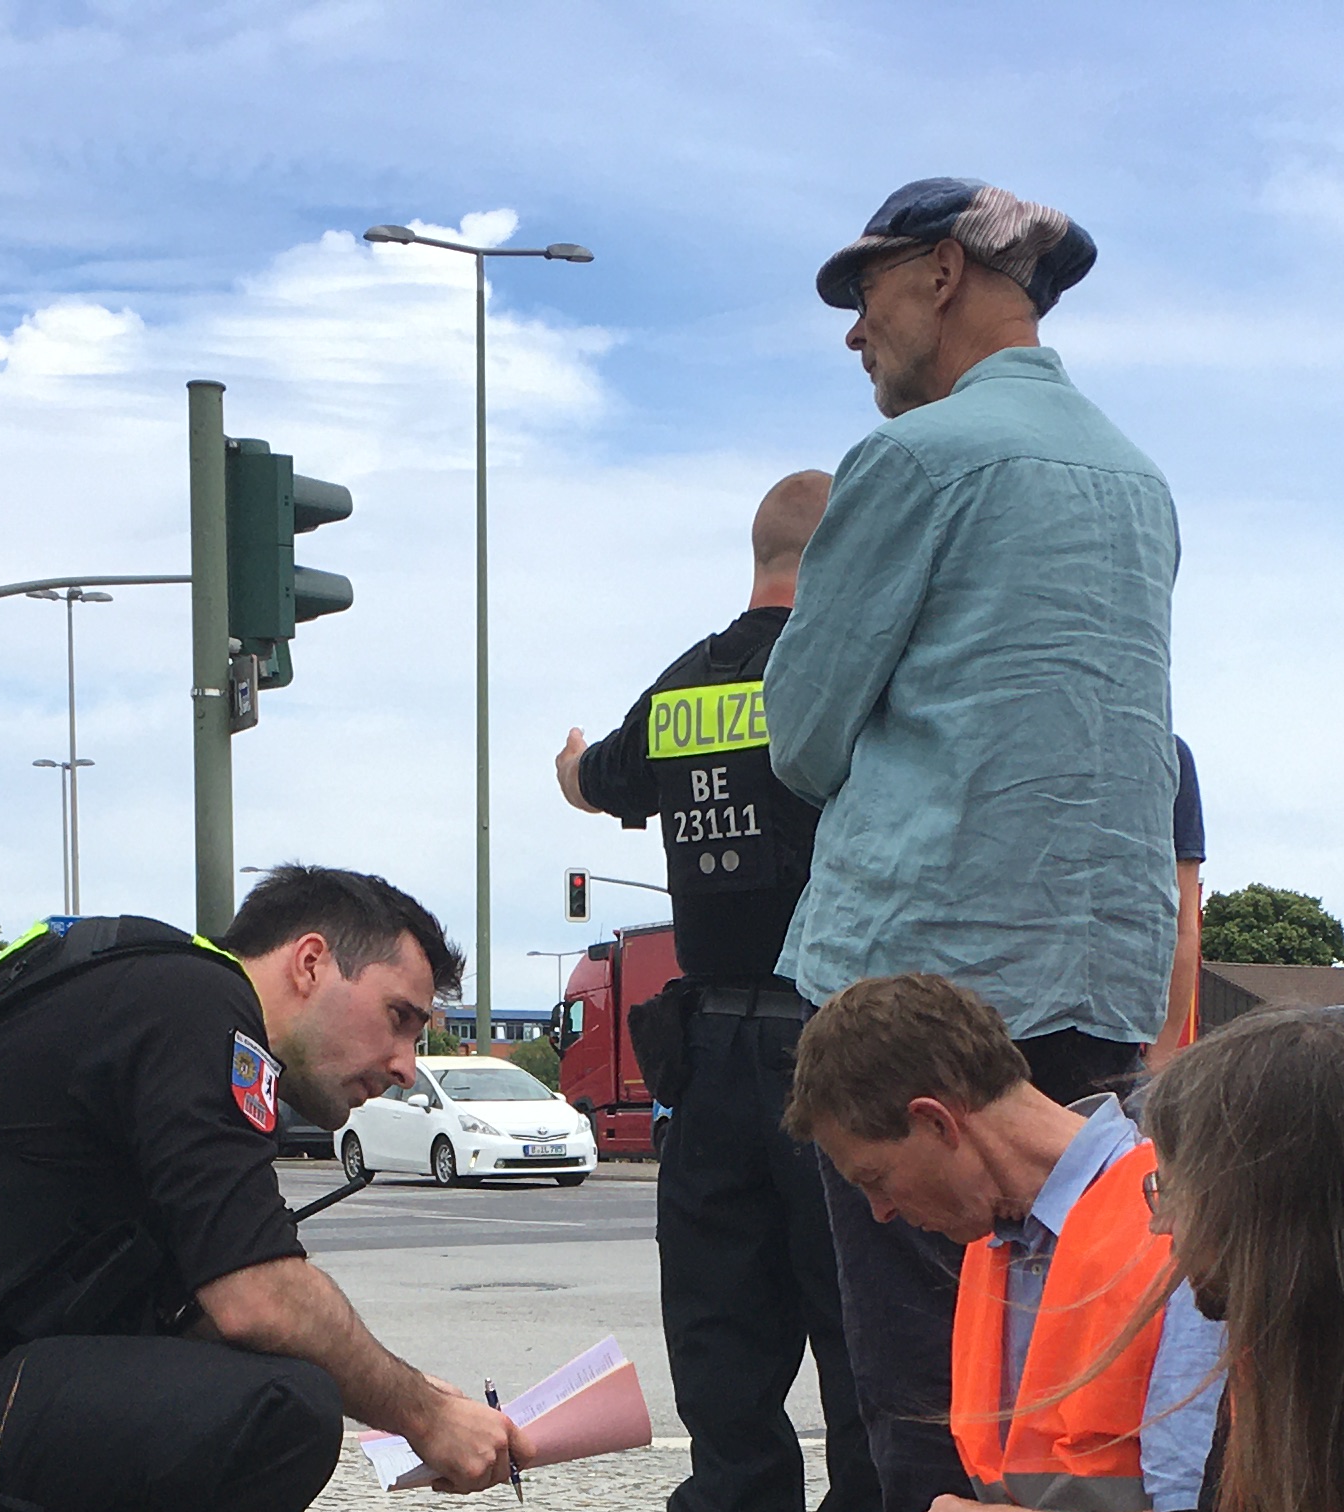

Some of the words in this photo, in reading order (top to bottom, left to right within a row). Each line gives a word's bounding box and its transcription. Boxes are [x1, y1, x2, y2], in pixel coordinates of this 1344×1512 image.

[654, 690, 768, 752] POLIZE
[690, 766, 730, 802] BE
[673, 803, 762, 844] 23111
